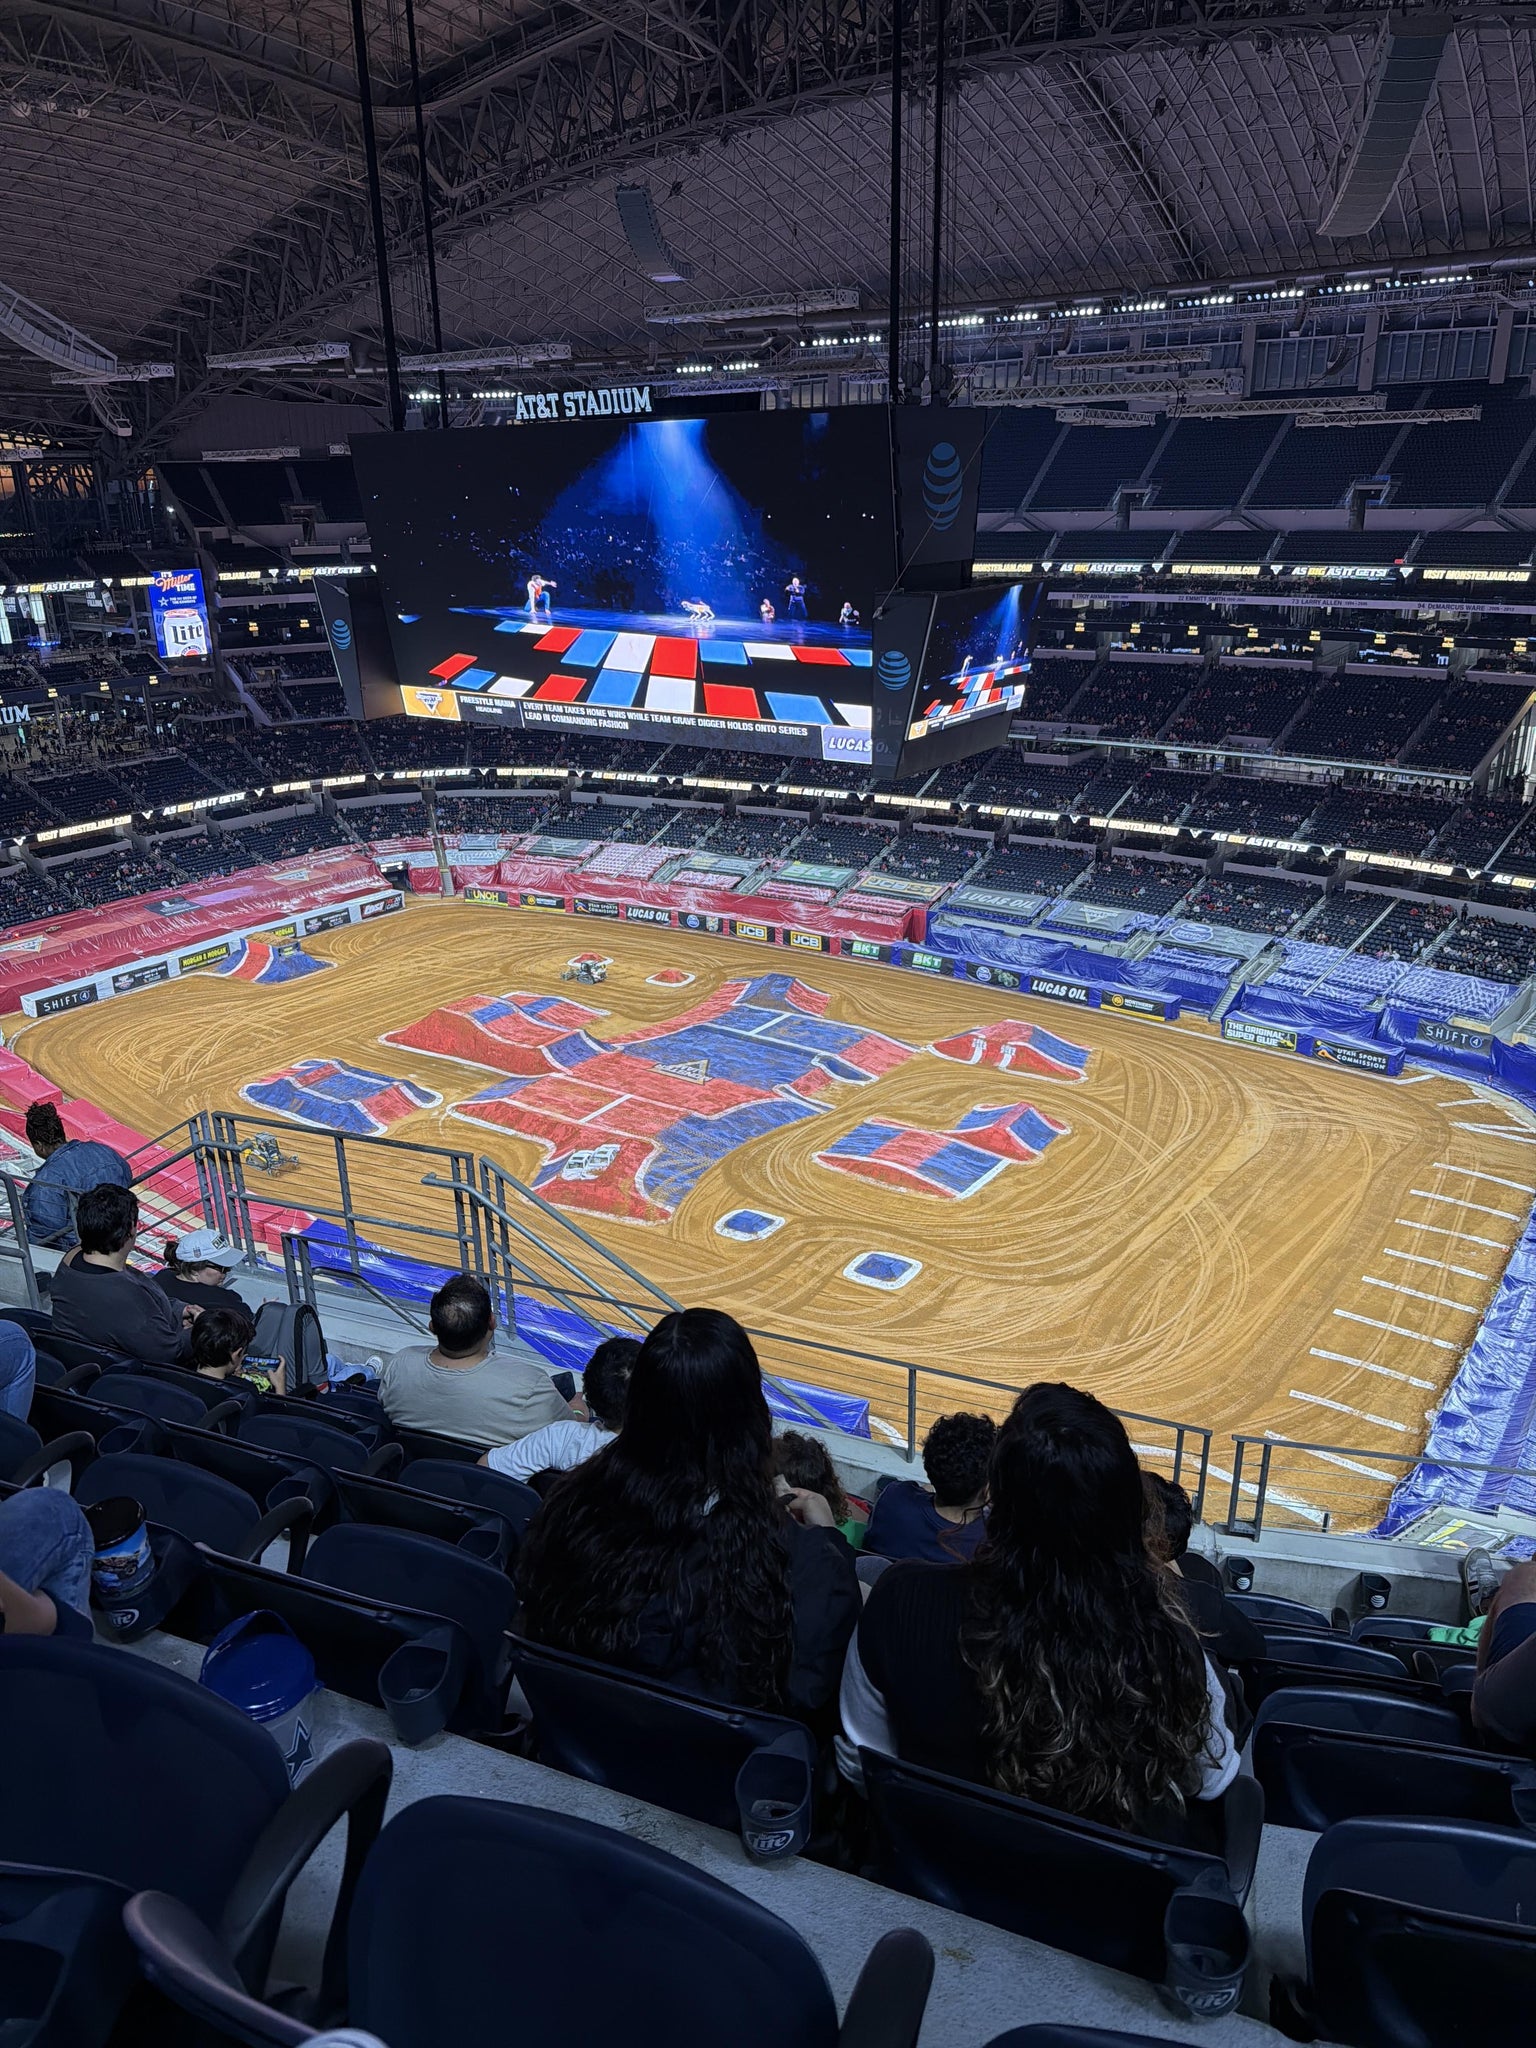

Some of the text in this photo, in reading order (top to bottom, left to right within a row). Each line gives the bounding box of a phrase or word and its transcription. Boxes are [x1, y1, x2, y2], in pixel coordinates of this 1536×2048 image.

[515, 386, 653, 420] AT&T STADIUM
[1171, 565, 1190, 574] VISIT
[1291, 567, 1307, 575] AS
[1307, 567, 1325, 576] BIG
[1325, 568, 1342, 577] AS
[1342, 568, 1356, 577] IT
[1423, 569, 1530, 582] VISIT MONSTERJAM.COM
[155, 574, 194, 592] Miller
[176, 583, 196, 592] TIME
[170, 624, 202, 645] Lite
[460, 696, 516, 708] FREESTYLE MANIA
[0, 704, 31, 725] UM
[476, 706, 503, 714] HEADLINE
[523, 701, 808, 737] EVERY TEAM TAKES HOME WINS WHILE TEAM GRAVE DIGGER HOLDS ONTO SERIES
[524, 711, 629, 730] LEAD IN COMMANDING FASHION
[828, 736, 872, 752] LUCAS
[36, 829, 59, 842] VISIT
[1345, 850, 1369, 863] VISIT
[1492, 874, 1535, 889] AS BIG
[472, 890, 499, 903] UNOH
[959, 891, 1036, 909] LUCAS OIL
[627, 907, 670, 922] LUCAS OIL
[738, 925, 765, 937] JCB
[792, 934, 819, 947] JCB
[852, 941, 880, 956] BKT
[182, 954, 203, 967] MORGAN
[207, 946, 227, 959] MORGAN
[913, 953, 942, 968] BKT
[1031, 979, 1087, 1001] LUCAS OIL
[1226, 1029, 1279, 1047] SUPER GLUE
[1227, 1021, 1283, 1040] THE ORIGINAL
[1336, 1048, 1387, 1064] UTAH SPORTS
[1336, 1055, 1386, 1070] COMMISSION
